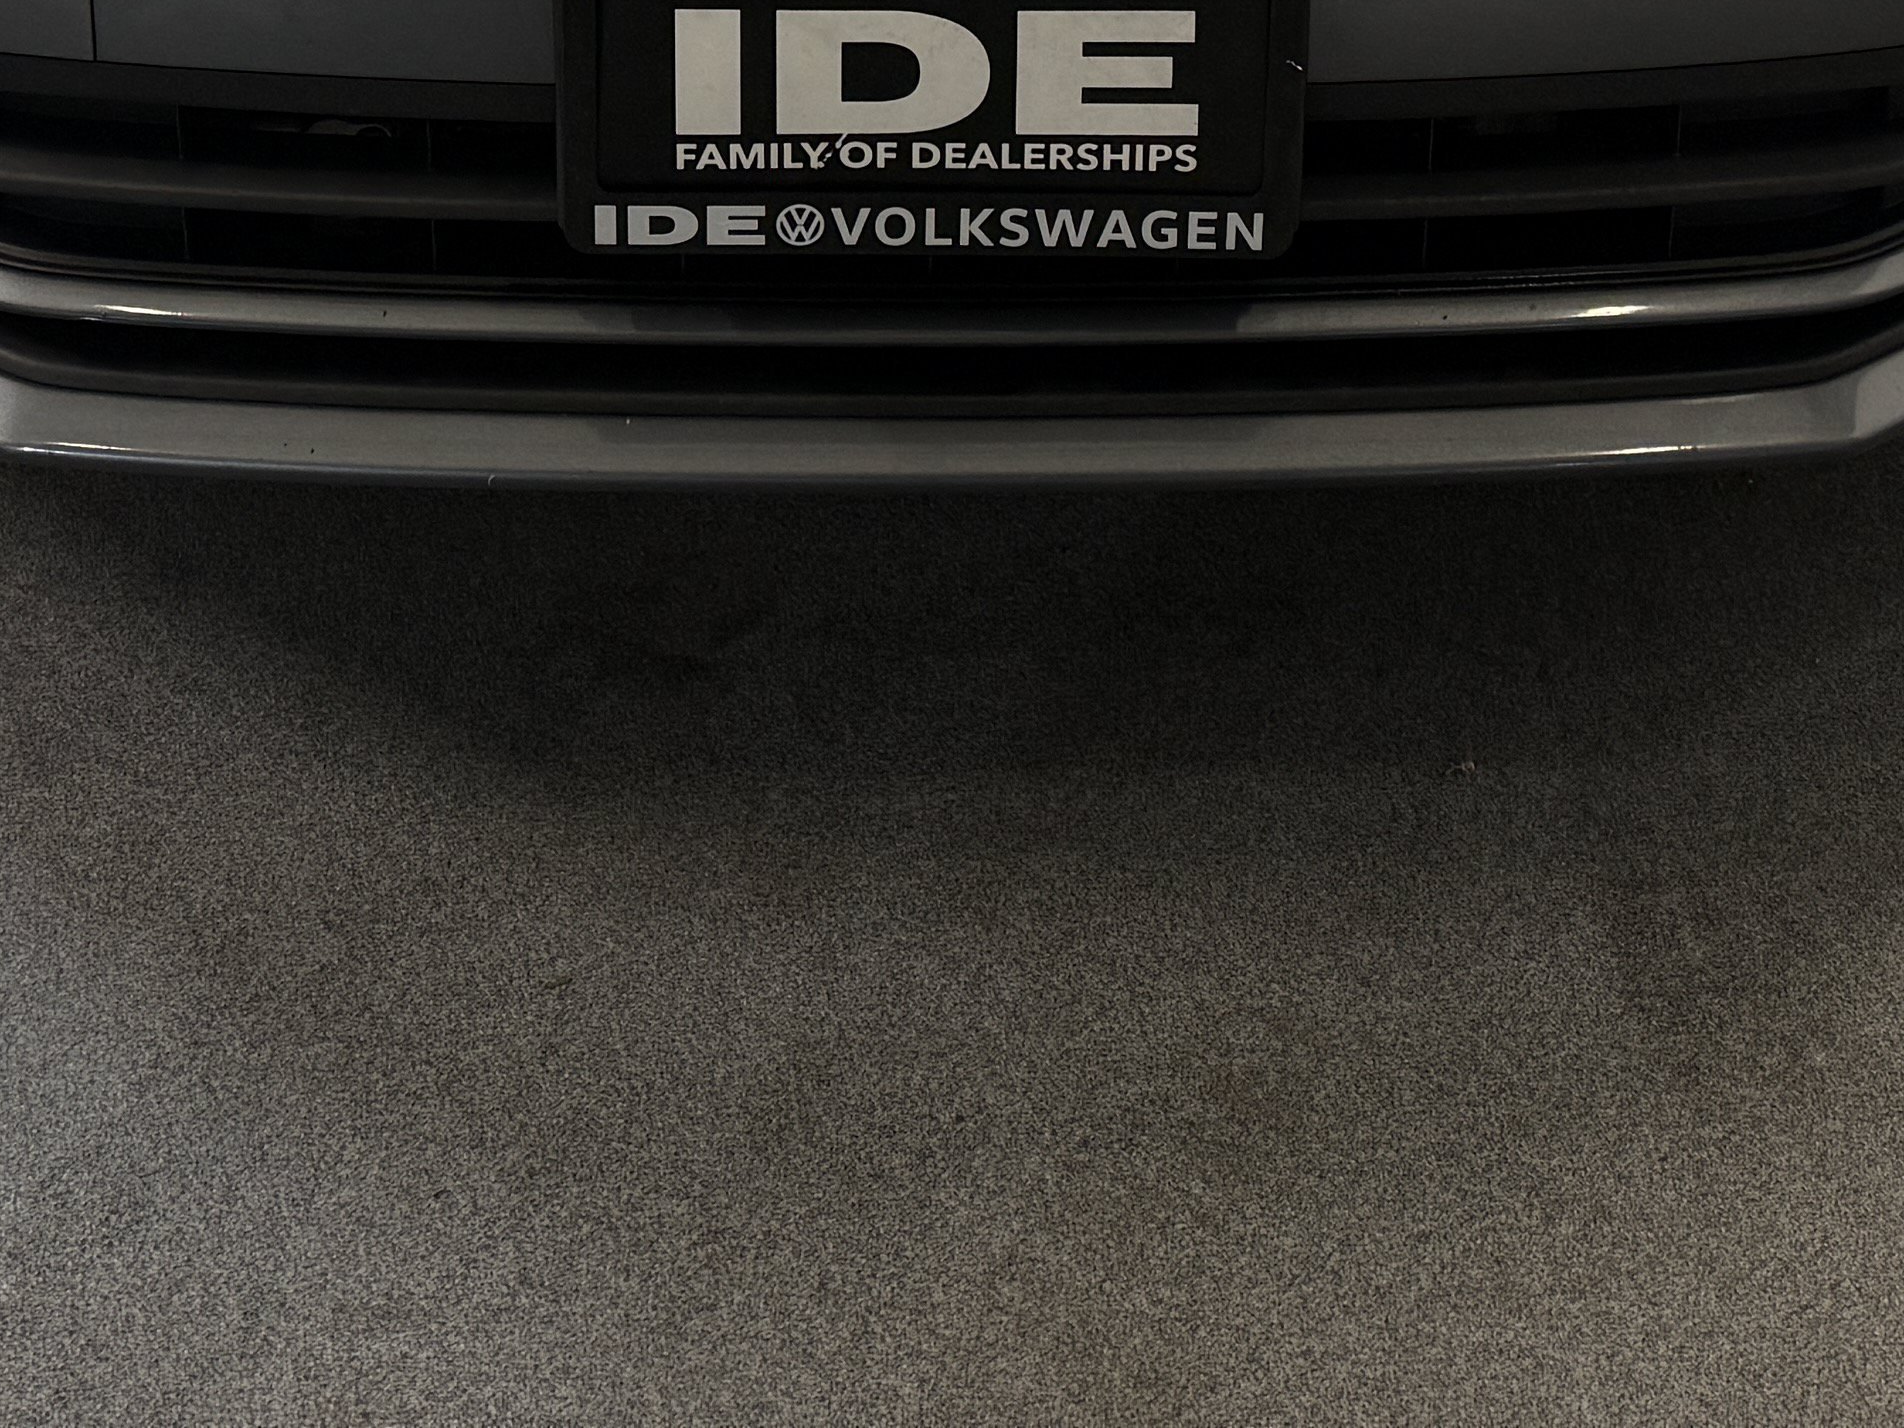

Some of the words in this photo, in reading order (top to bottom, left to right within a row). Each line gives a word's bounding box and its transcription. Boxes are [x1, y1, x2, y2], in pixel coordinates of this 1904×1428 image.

[674, 8, 1199, 137] IDE
[675, 141, 830, 170] FAMILY
[839, 141, 898, 170] OF
[911, 142, 1198, 172] DEALERSHIPS
[594, 204, 767, 246] IDE
[830, 206, 1265, 251] VOLKSWAGEN
